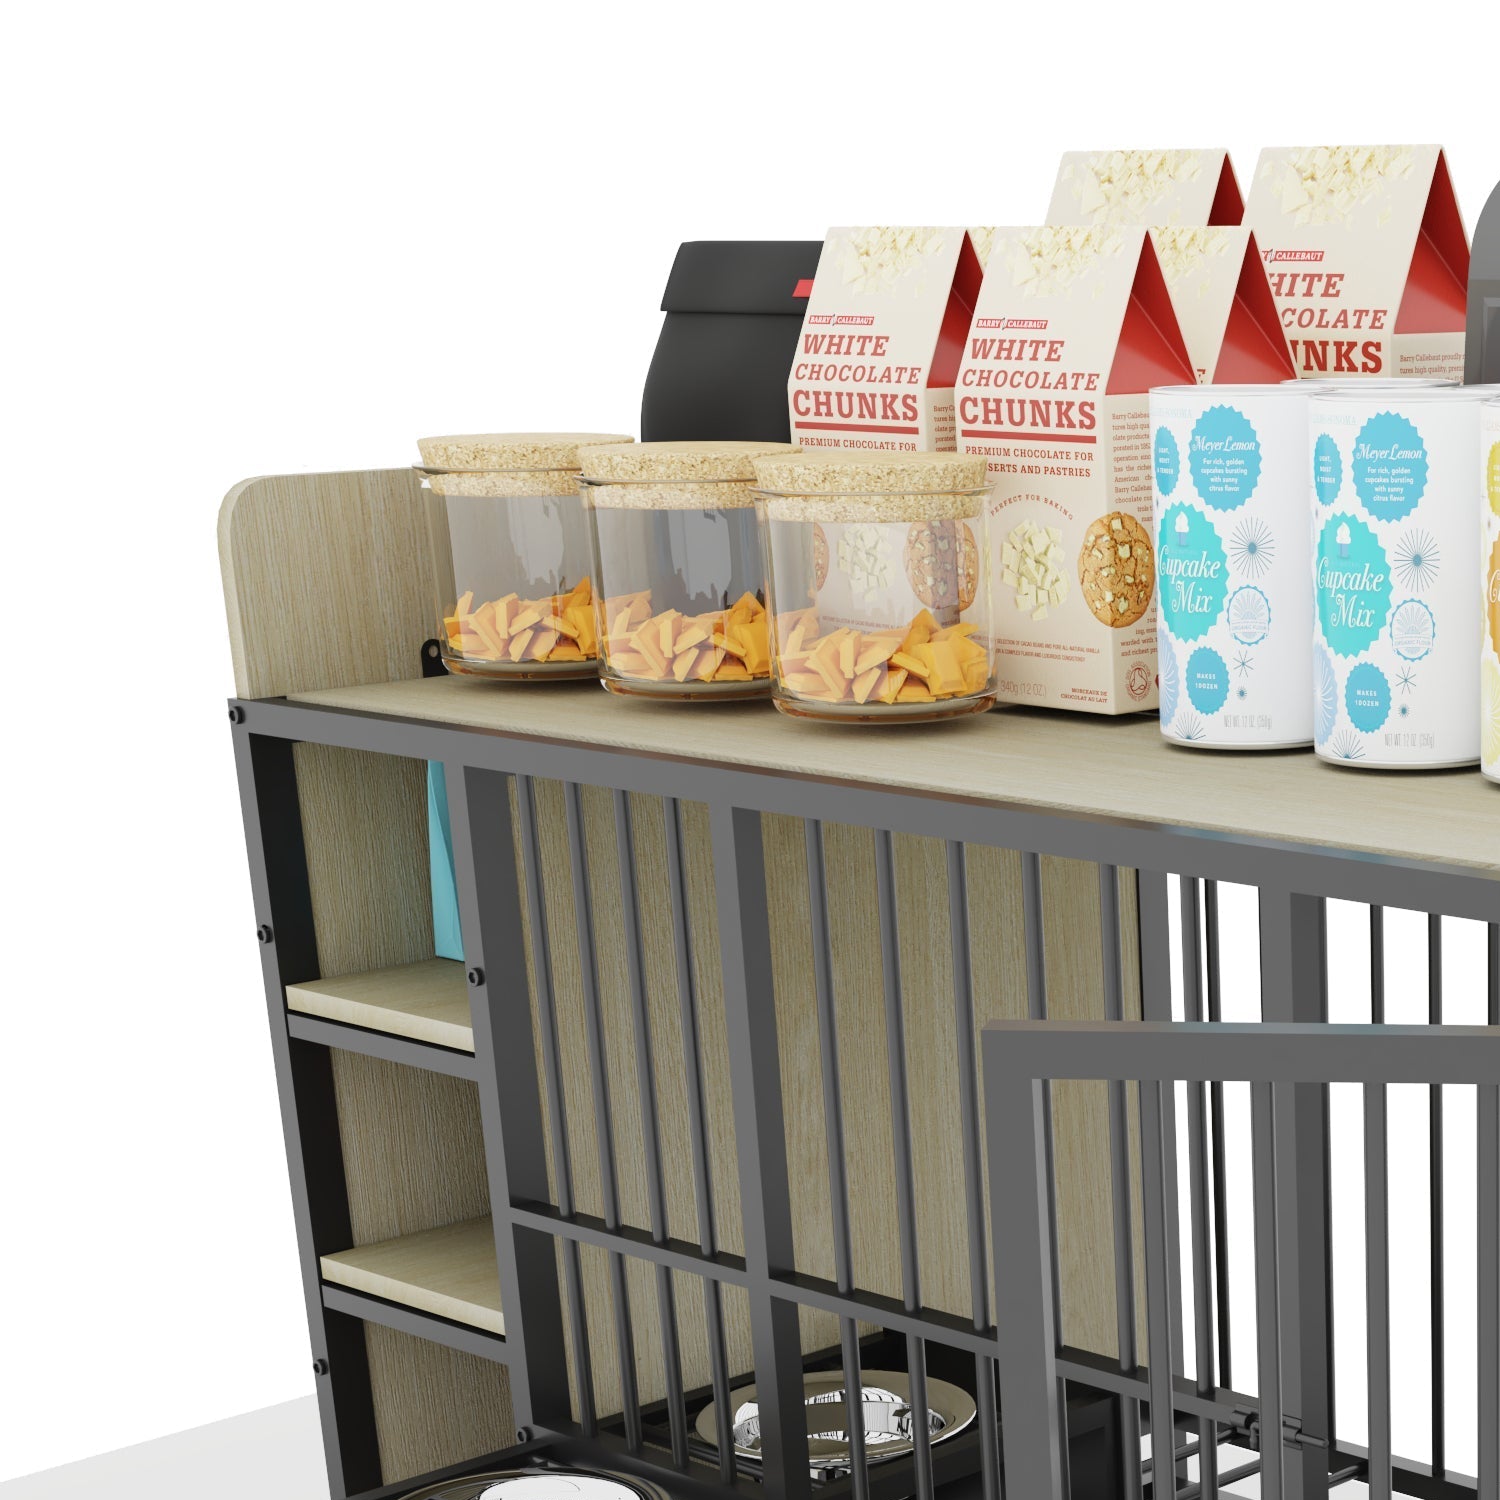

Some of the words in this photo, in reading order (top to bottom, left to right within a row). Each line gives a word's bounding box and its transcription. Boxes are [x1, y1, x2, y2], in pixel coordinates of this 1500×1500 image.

[1276, 252, 1322, 260] CALLEBAUT
[1269, 274, 1344, 297] HITE
[810, 315, 831, 325] BARRY
[837, 316, 874, 325] CALLEBAUT
[977, 319, 1000, 328] BARRY
[1007, 320, 1047, 329] CALLEBAUT
[1282, 308, 1387, 329] COLATE
[803, 334, 889, 356] WHITE
[971, 339, 1064, 362] WHITE
[1290, 340, 1382, 373] NKS
[795, 364, 921, 385] CHOCOLATE
[962, 369, 1100, 391] CHOCOLATE
[793, 389, 919, 421] CHUNKS
[960, 396, 1096, 430] CHUNKS
[799, 437, 840, 448] PREMIUM
[843, 439, 896, 451] CHOCOLATE
[899, 442, 917, 452] FOR
[966, 446, 1010, 457] PREMIUM
[1014, 449, 1071, 459] CHOCOLATE
[1075, 451, 1093, 461] FOR
[1192, 435, 1224, 454] Meyer
[1224, 435, 1256, 452] Lemon
[1356, 444, 1389, 463] Meyer
[1389, 444, 1422, 460] Lemon
[988, 463, 1017, 473] SERTS
[1021, 465, 1040, 474] AND
[1044, 466, 1091, 477] PASTRIES
[1201, 467, 1224, 475] cupcakes
[1226, 467, 1248, 475] bursting
[1226, 458, 1244, 466] golden
[1391, 467, 1410, 476] golden
[1391, 477, 1414, 485] bursting
[991, 495, 1022, 517] PERFECT
[1044, 498, 1073, 520] BAKING
[1160, 545, 1220, 584] Cupcake
[1318, 556, 1384, 597] Cupcake
[1172, 581, 1212, 613] Mix
[1331, 593, 1375, 628] Mix
[1001, 680, 1018, 693] 340g
